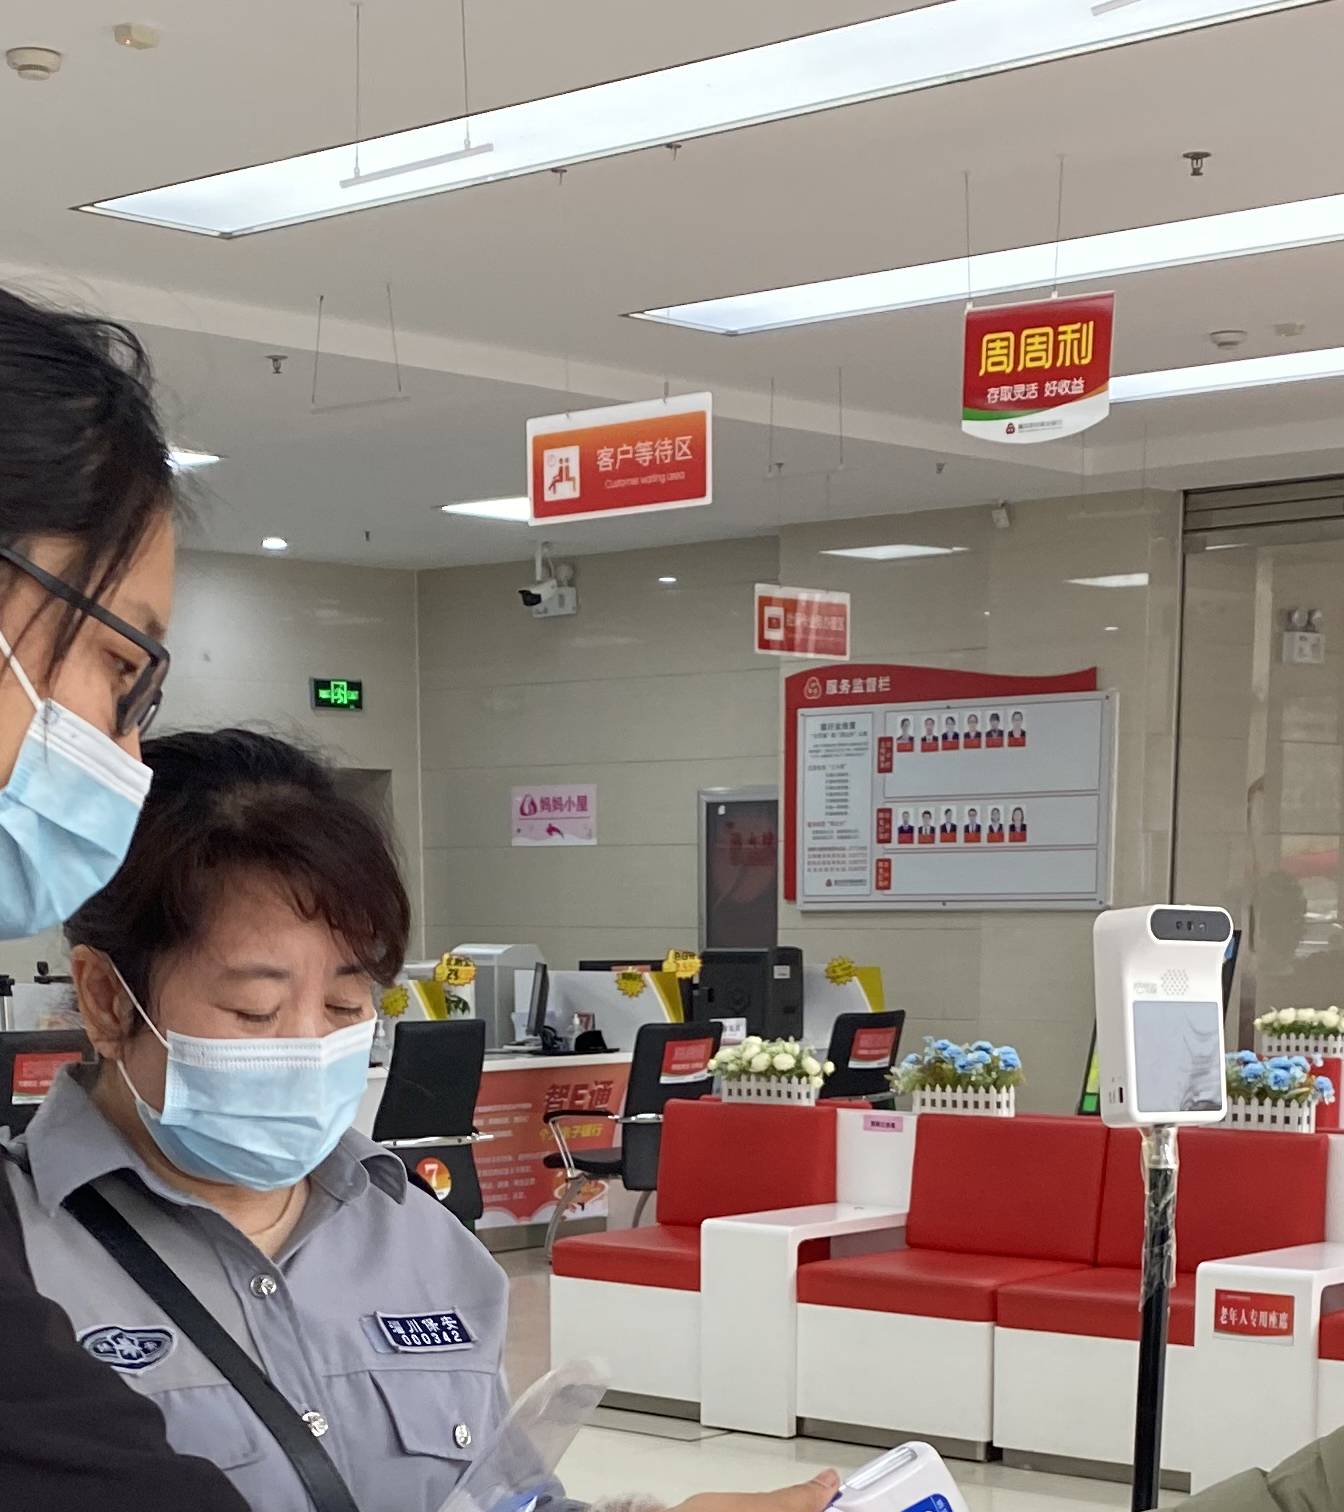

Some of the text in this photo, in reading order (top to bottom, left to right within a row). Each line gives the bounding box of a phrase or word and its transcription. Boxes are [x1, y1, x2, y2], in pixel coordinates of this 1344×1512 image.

[978, 321, 1094, 376] 周周利
[987, 377, 1085, 403] 存取灵活 好收益
[596, 435, 693, 472] 客户等待区
[825, 676, 891, 695] 服务监督栏
[540, 795, 588, 812] 妈妈小屋
[425, 1164, 439, 1188] 7
[401, 1330, 463, 1345] 000342
